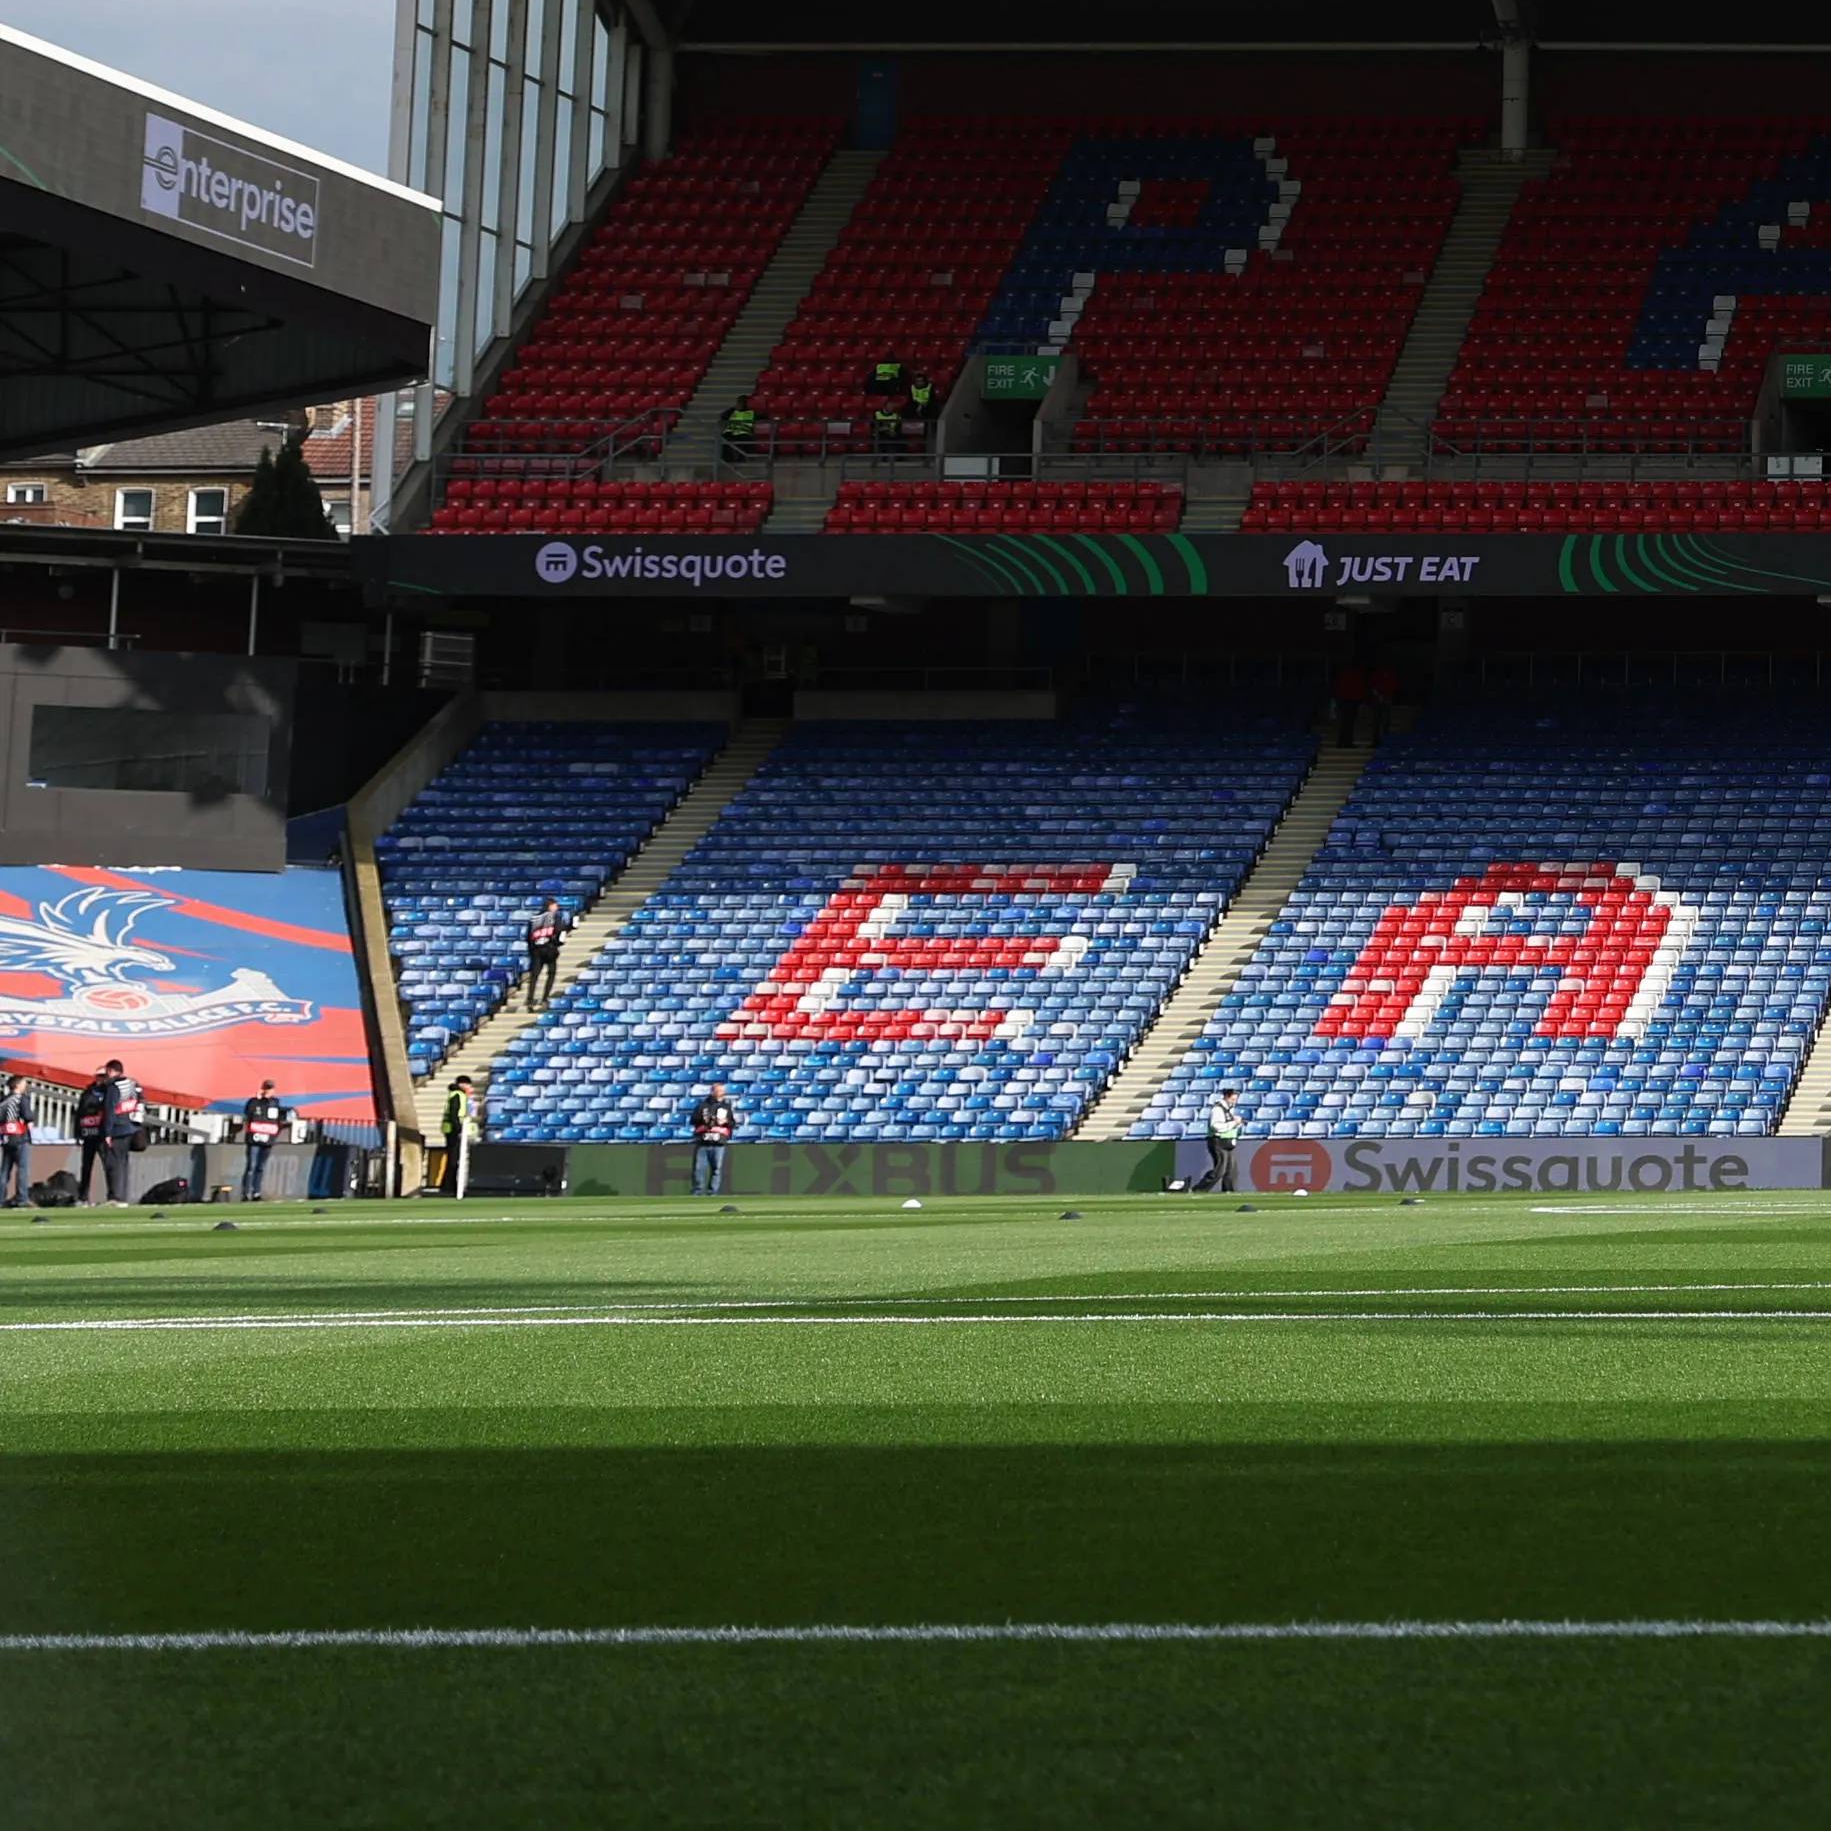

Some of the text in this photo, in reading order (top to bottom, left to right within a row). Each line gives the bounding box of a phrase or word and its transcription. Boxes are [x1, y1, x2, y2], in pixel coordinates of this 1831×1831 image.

[144, 145, 314, 239] enterprise
[987, 365, 1015, 376] FIRE
[987, 378, 1014, 389] EXIT
[1786, 364, 1814, 375] FIRE
[1786, 377, 1813, 388] EXIT
[582, 546, 786, 586] Swissquote
[1337, 556, 1480, 585] JUST EAT
[0, 1001, 291, 1032] RYSTAL PALACE F.C.
[1343, 1140, 1749, 1193] Swissquote
